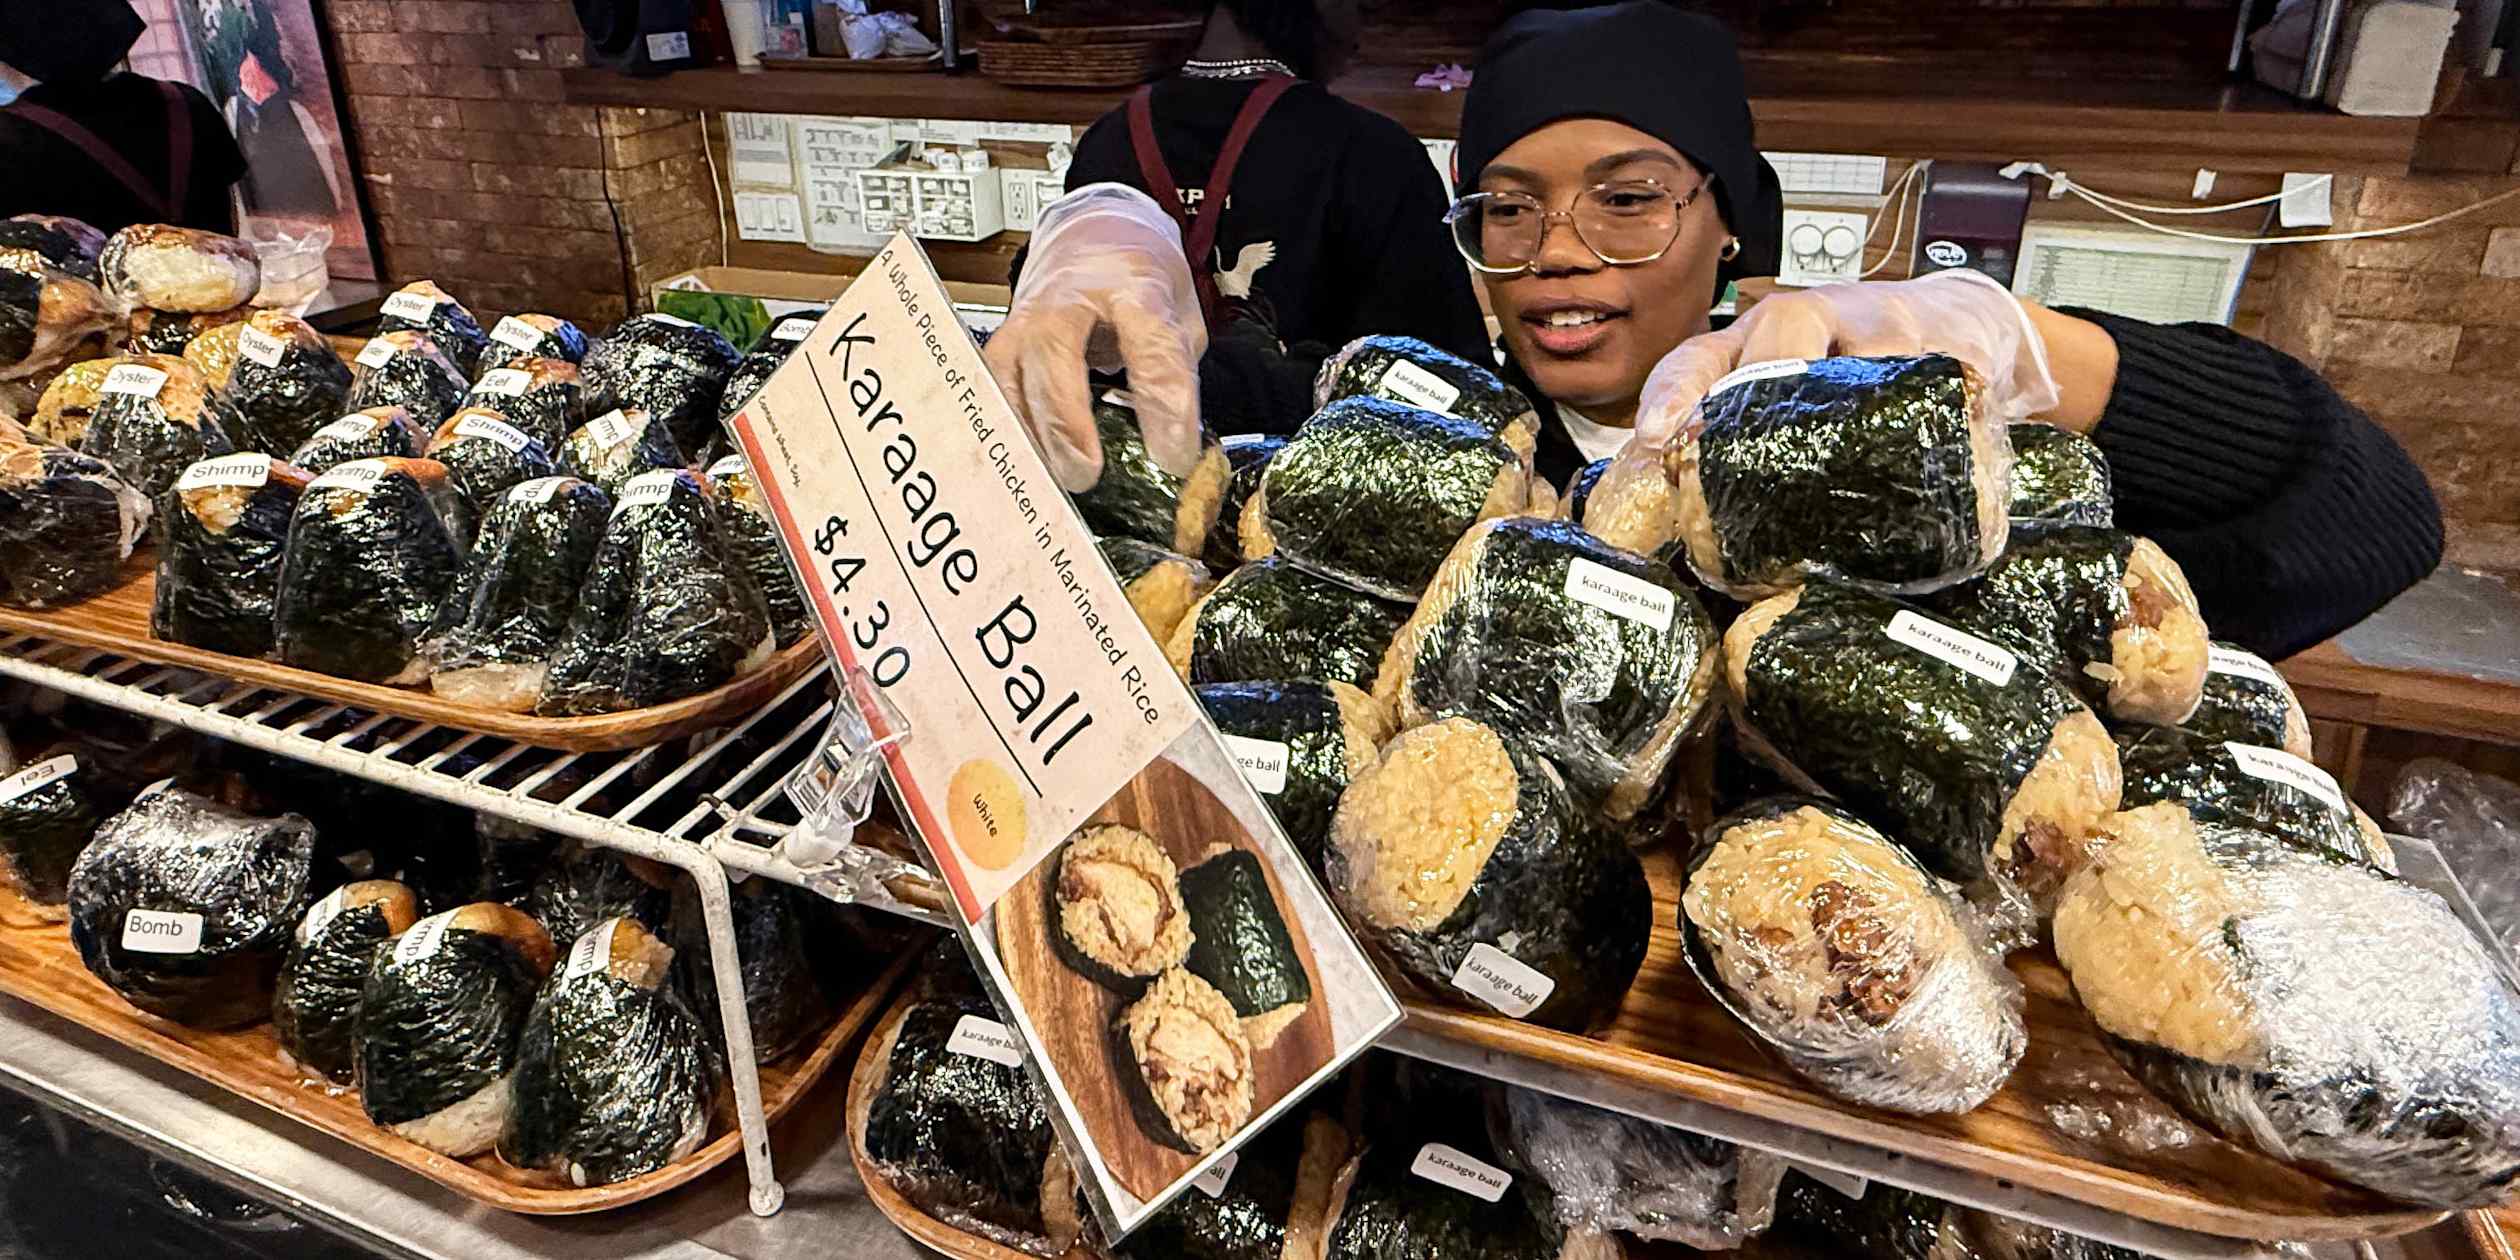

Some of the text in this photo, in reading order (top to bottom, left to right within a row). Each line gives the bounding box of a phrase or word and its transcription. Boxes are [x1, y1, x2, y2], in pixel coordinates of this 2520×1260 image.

[242, 330, 276, 358] Oyster
[486, 374, 511, 387] Eel
[881, 250, 1159, 724] A Whole Piece of Fried Chicken in Marinated Rice
[829, 312, 978, 597] Karaage
[975, 595, 1093, 767] Ball
[814, 515, 912, 689] $4.30
[1581, 574, 1667, 616] karaage ball
[1907, 621, 2007, 674] karaage ball
[21, 764, 54, 787] Eel
[1256, 758, 1281, 773] ball
[972, 792, 999, 839] White
[129, 916, 184, 938] Bomb
[1465, 956, 1540, 1006] karaage ball
[961, 1028, 1004, 1049] karaage
[1208, 1162, 1226, 1181] all
[1427, 1152, 1502, 1189] karaage ball
